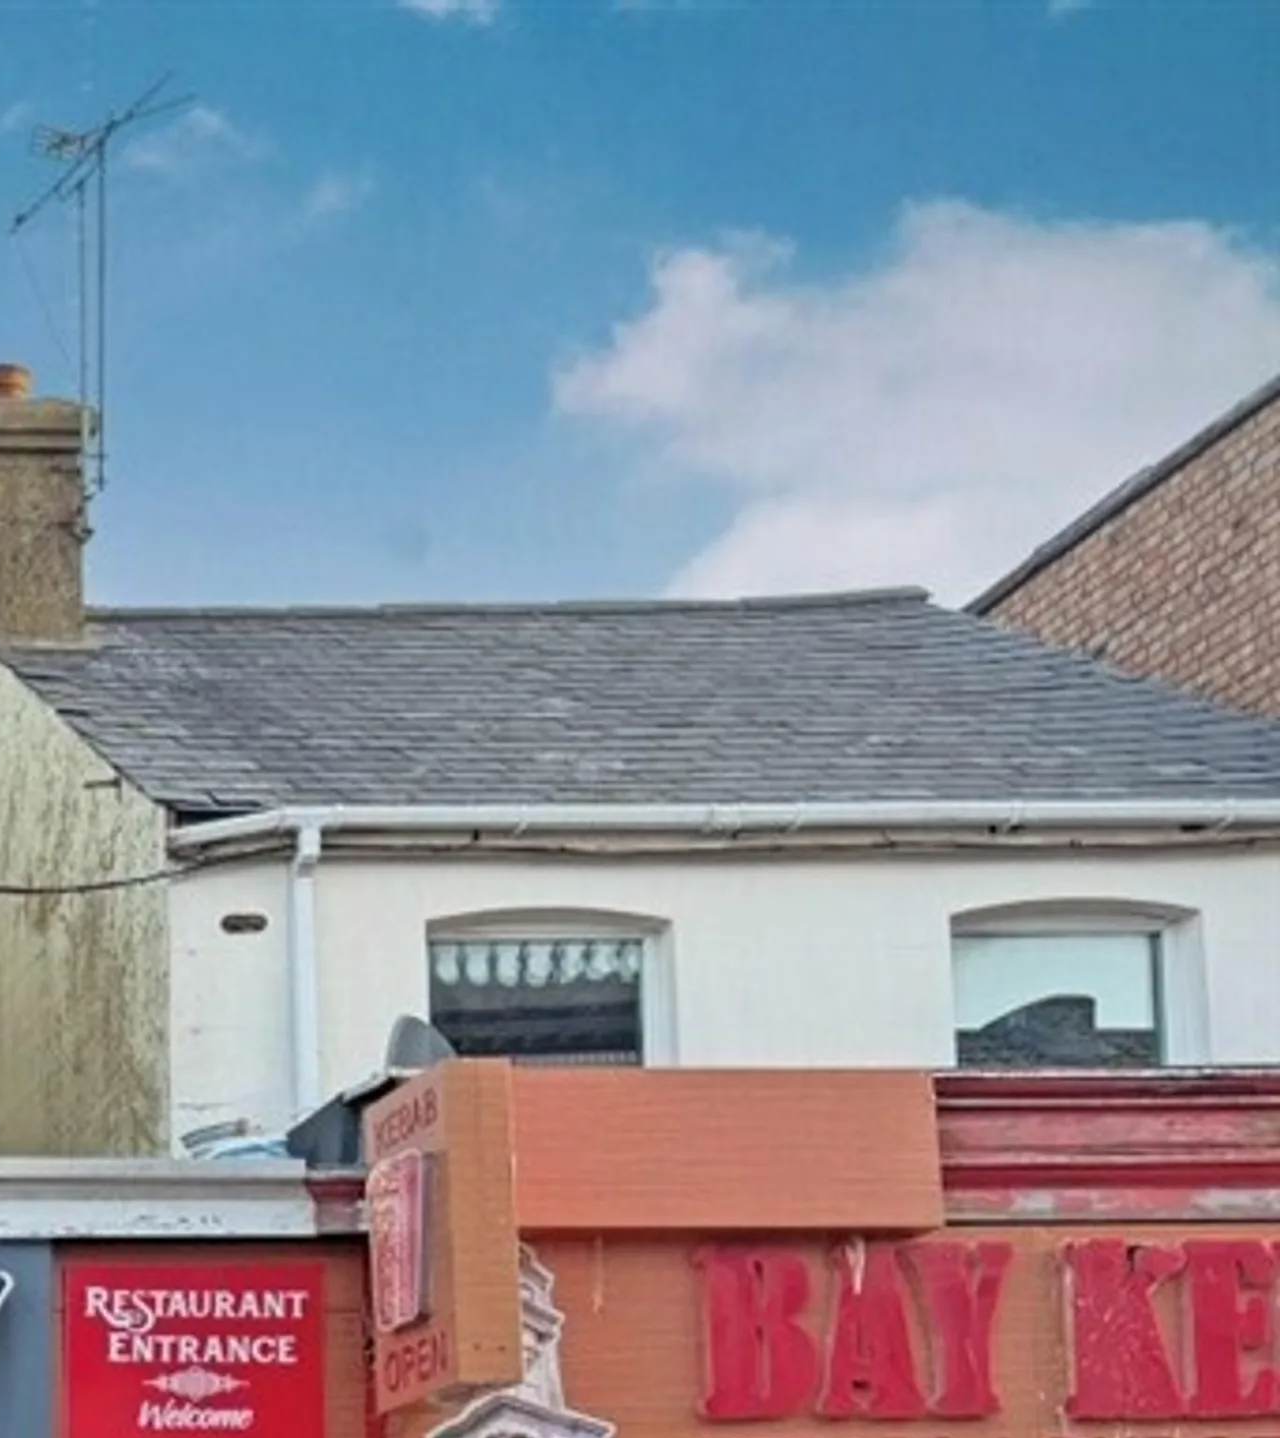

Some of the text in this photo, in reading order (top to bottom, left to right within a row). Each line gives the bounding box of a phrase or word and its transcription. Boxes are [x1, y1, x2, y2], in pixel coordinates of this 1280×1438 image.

[373, 1088, 439, 1153] KEBAB
[83, 1284, 309, 1334] RESTAURANT
[689, 1236, 1280, 1423] BAY KE
[107, 1331, 298, 1364] ENTRANCE
[384, 1331, 448, 1394] OPEN
[138, 1399, 255, 1432] Welcome
